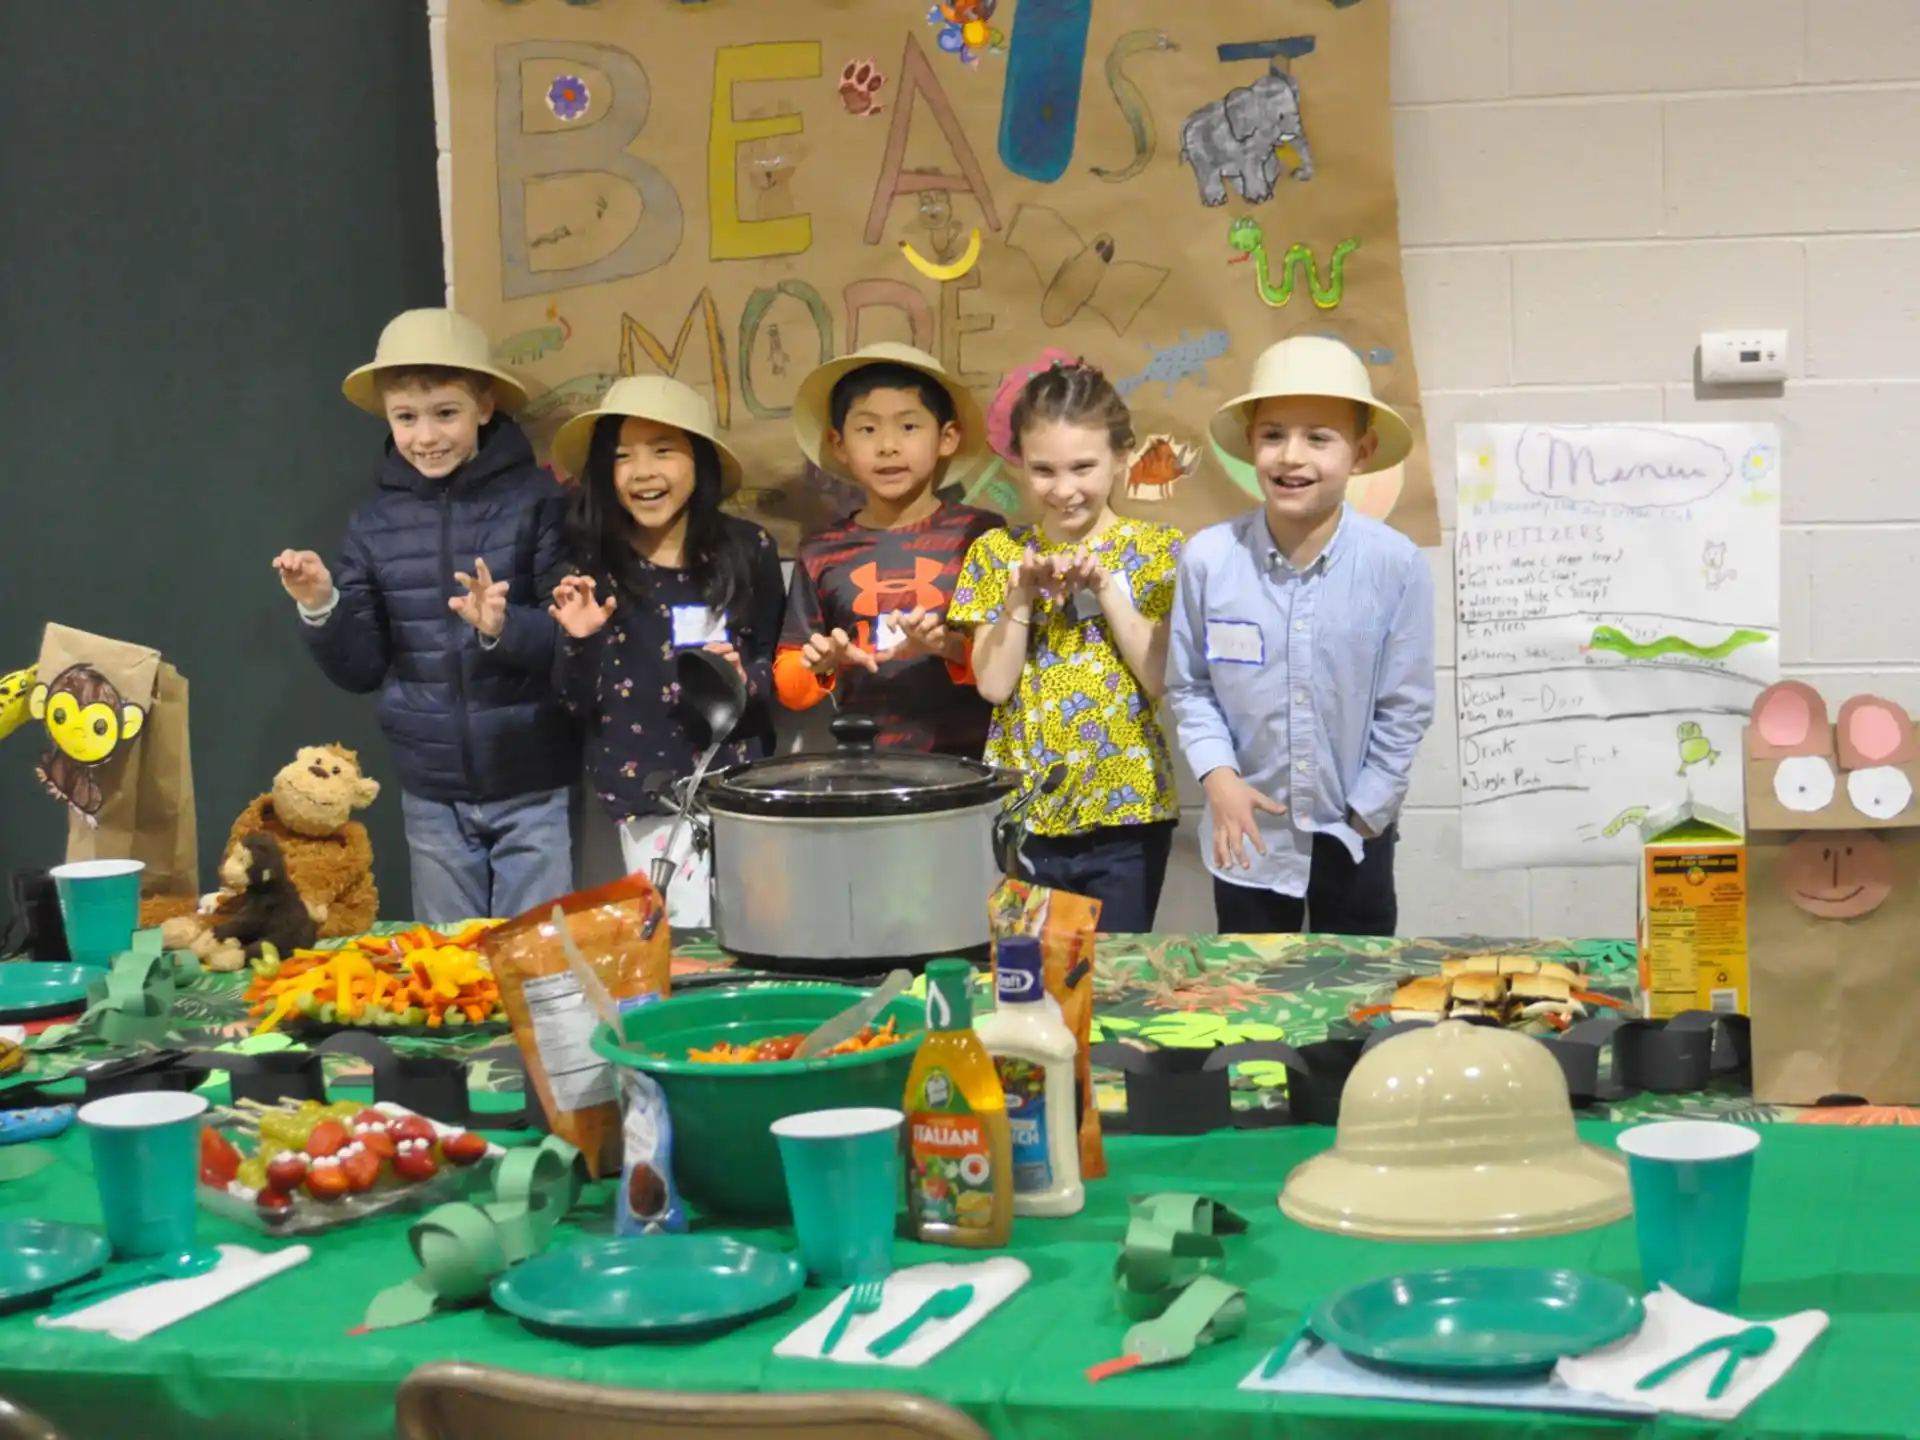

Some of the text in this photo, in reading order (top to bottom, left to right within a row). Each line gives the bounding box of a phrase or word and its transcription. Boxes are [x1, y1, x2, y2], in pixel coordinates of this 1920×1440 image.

[618, 268, 995, 430] MODE
[1458, 525, 1605, 558] APPETIZERS
[912, 1123, 979, 1146] ITALIAN
